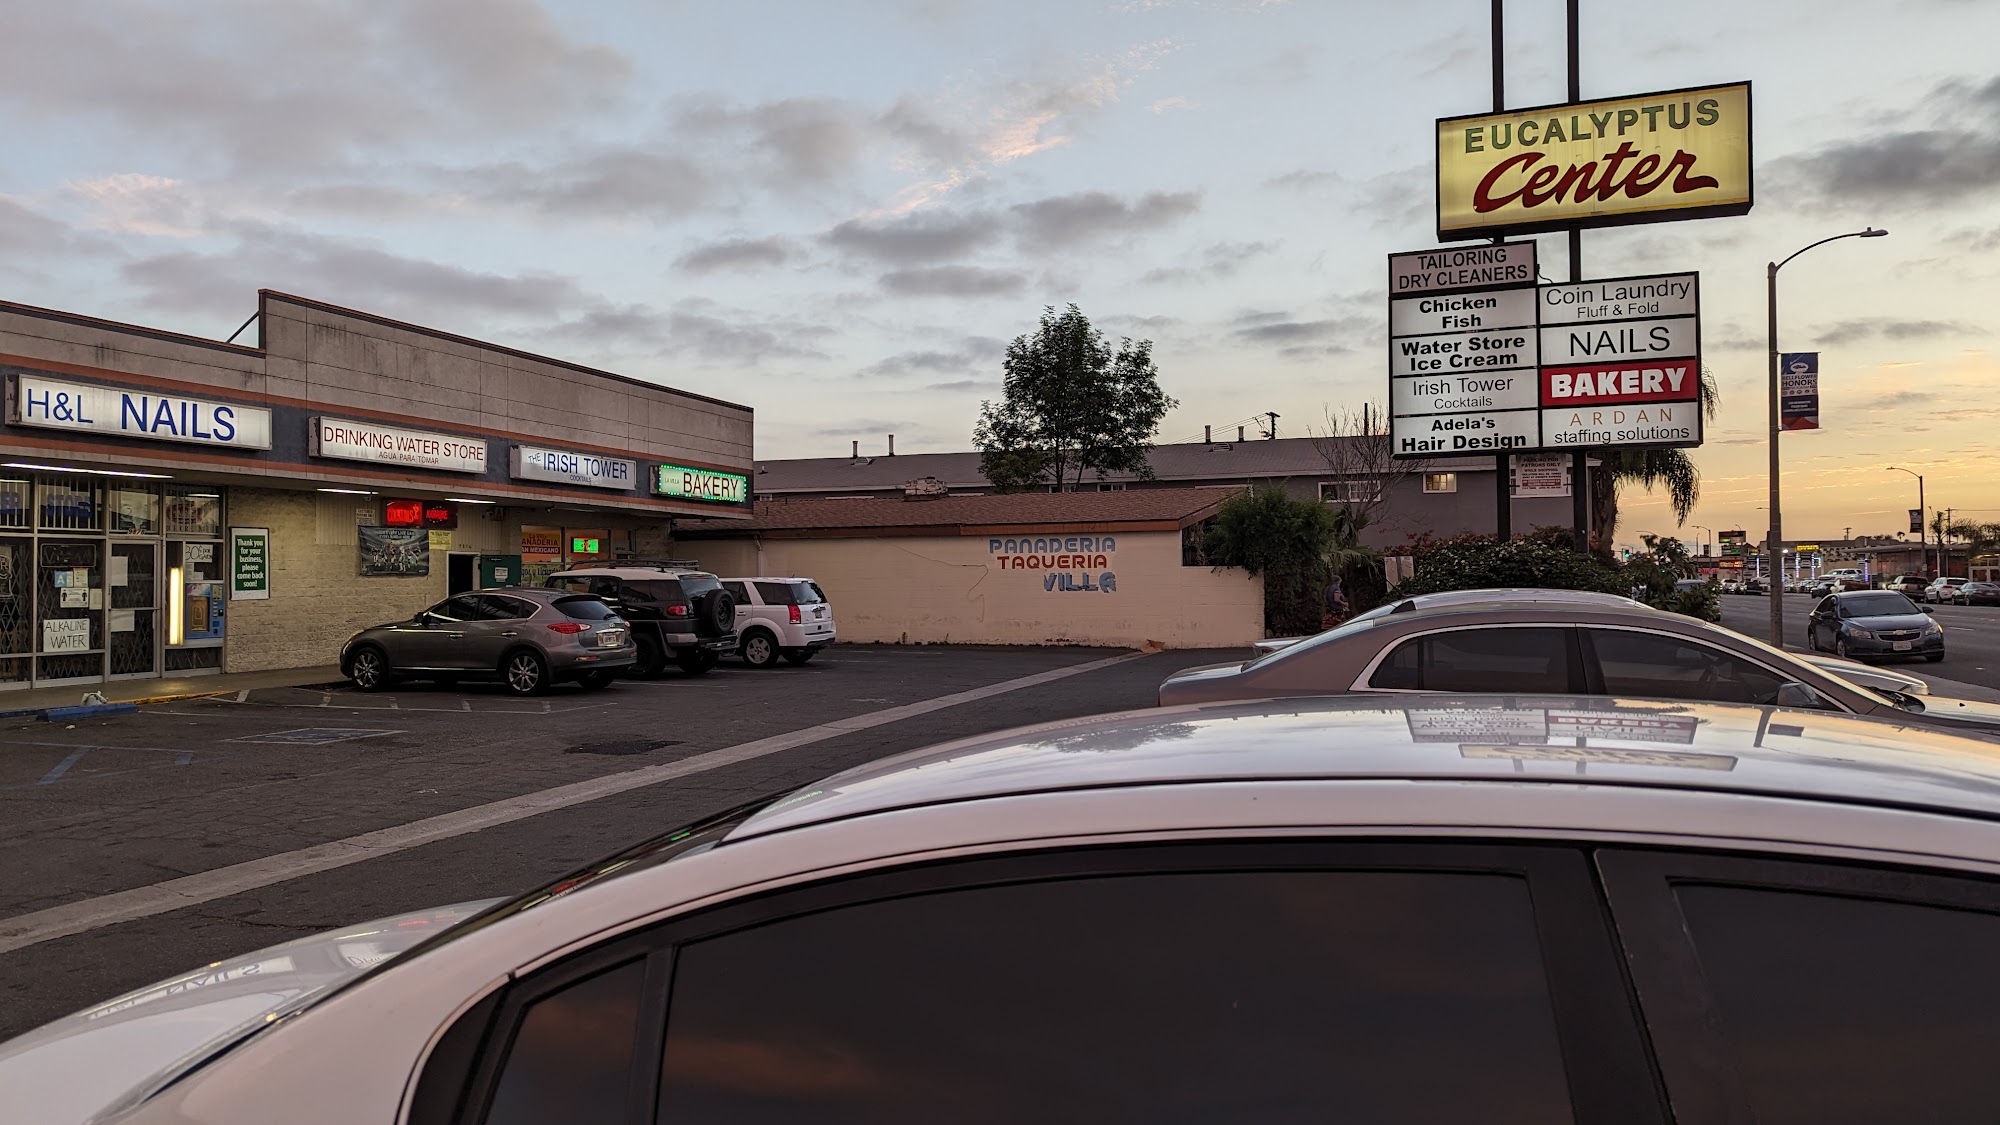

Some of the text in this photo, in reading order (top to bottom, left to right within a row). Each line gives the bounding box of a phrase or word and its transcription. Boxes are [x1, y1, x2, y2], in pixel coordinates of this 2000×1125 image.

[1465, 98, 1720, 154] EUCALYPTUS
[1472, 141, 1719, 214] Center
[1417, 249, 1507, 270] TAILORING
[1399, 264, 1528, 289] DRY CLEANERS
[1546, 279, 1691, 305] Coin Laundry
[1419, 297, 1497, 314] Chicken
[1577, 301, 1659, 318] Fluff & Fold
[1442, 314, 1482, 329] Fish
[1401, 336, 1526, 356] Water Store
[1570, 326, 1671, 357] NAILS
[1410, 353, 1518, 371] Ice Cream
[1413, 377, 1514, 396] Irish Tower
[1551, 367, 1687, 398] BAKERY
[1782, 379, 1817, 388] HONORS
[1434, 396, 1493, 410] Cocktails
[27, 388, 235, 441] H&L NAILS
[1570, 408, 1672, 427] ARDAN
[1431, 417, 1496, 431] Adela's
[324, 426, 484, 461] DRINKING WATER STORE
[1401, 433, 1526, 452] Hair Design
[1554, 426, 1690, 444] staffing solutions
[378, 451, 439, 464] AGUA PARA TOMAR
[528, 452, 628, 480] THE IRISH TOWER
[569, 474, 592, 484] COCKTAILS
[683, 472, 739, 499] BAKERY
[237, 538, 264, 548] Thank you
[522, 538, 559, 546] ANADERIA
[989, 536, 1116, 554] PANADERIA
[239, 555, 263, 563] business,
[249, 548, 262, 556] your
[241, 563, 259, 572] please
[997, 554, 1107, 570] TAQUERIA
[57, 575, 65, 584] A
[251, 571, 264, 579] back
[1043, 571, 1117, 594] VILLA
[44, 620, 87, 632] ALKALINE
[50, 635, 86, 649] WATER
